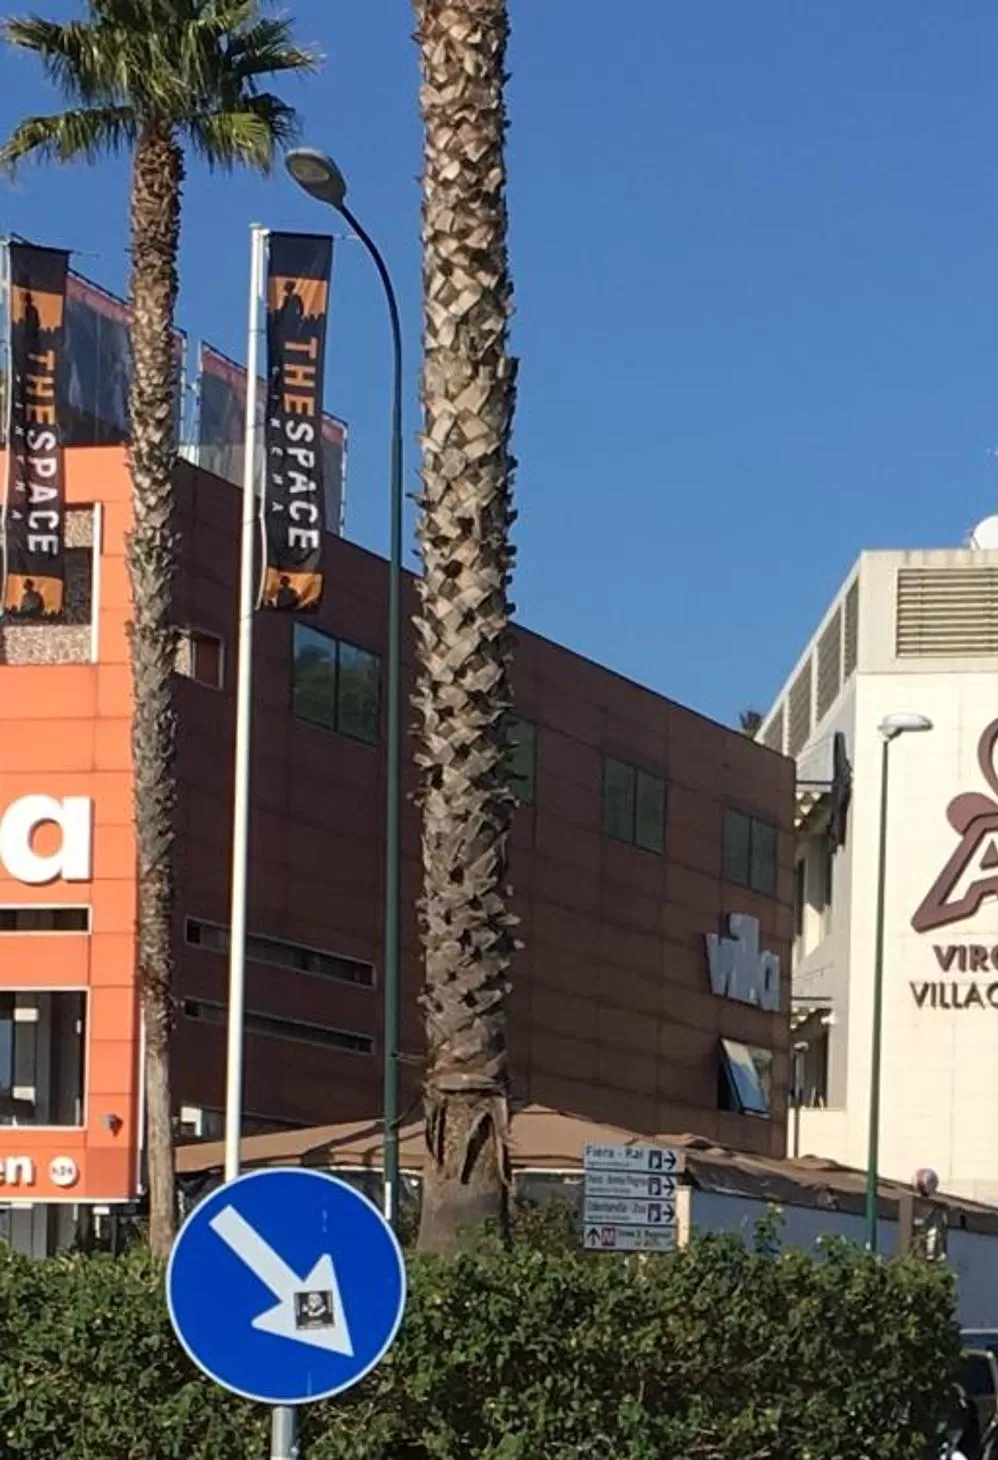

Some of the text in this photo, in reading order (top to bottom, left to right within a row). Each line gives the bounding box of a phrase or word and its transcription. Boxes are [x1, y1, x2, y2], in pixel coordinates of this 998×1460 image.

[26, 350, 60, 555] THE SPACE
[282, 337, 321, 549] THE SPACE
